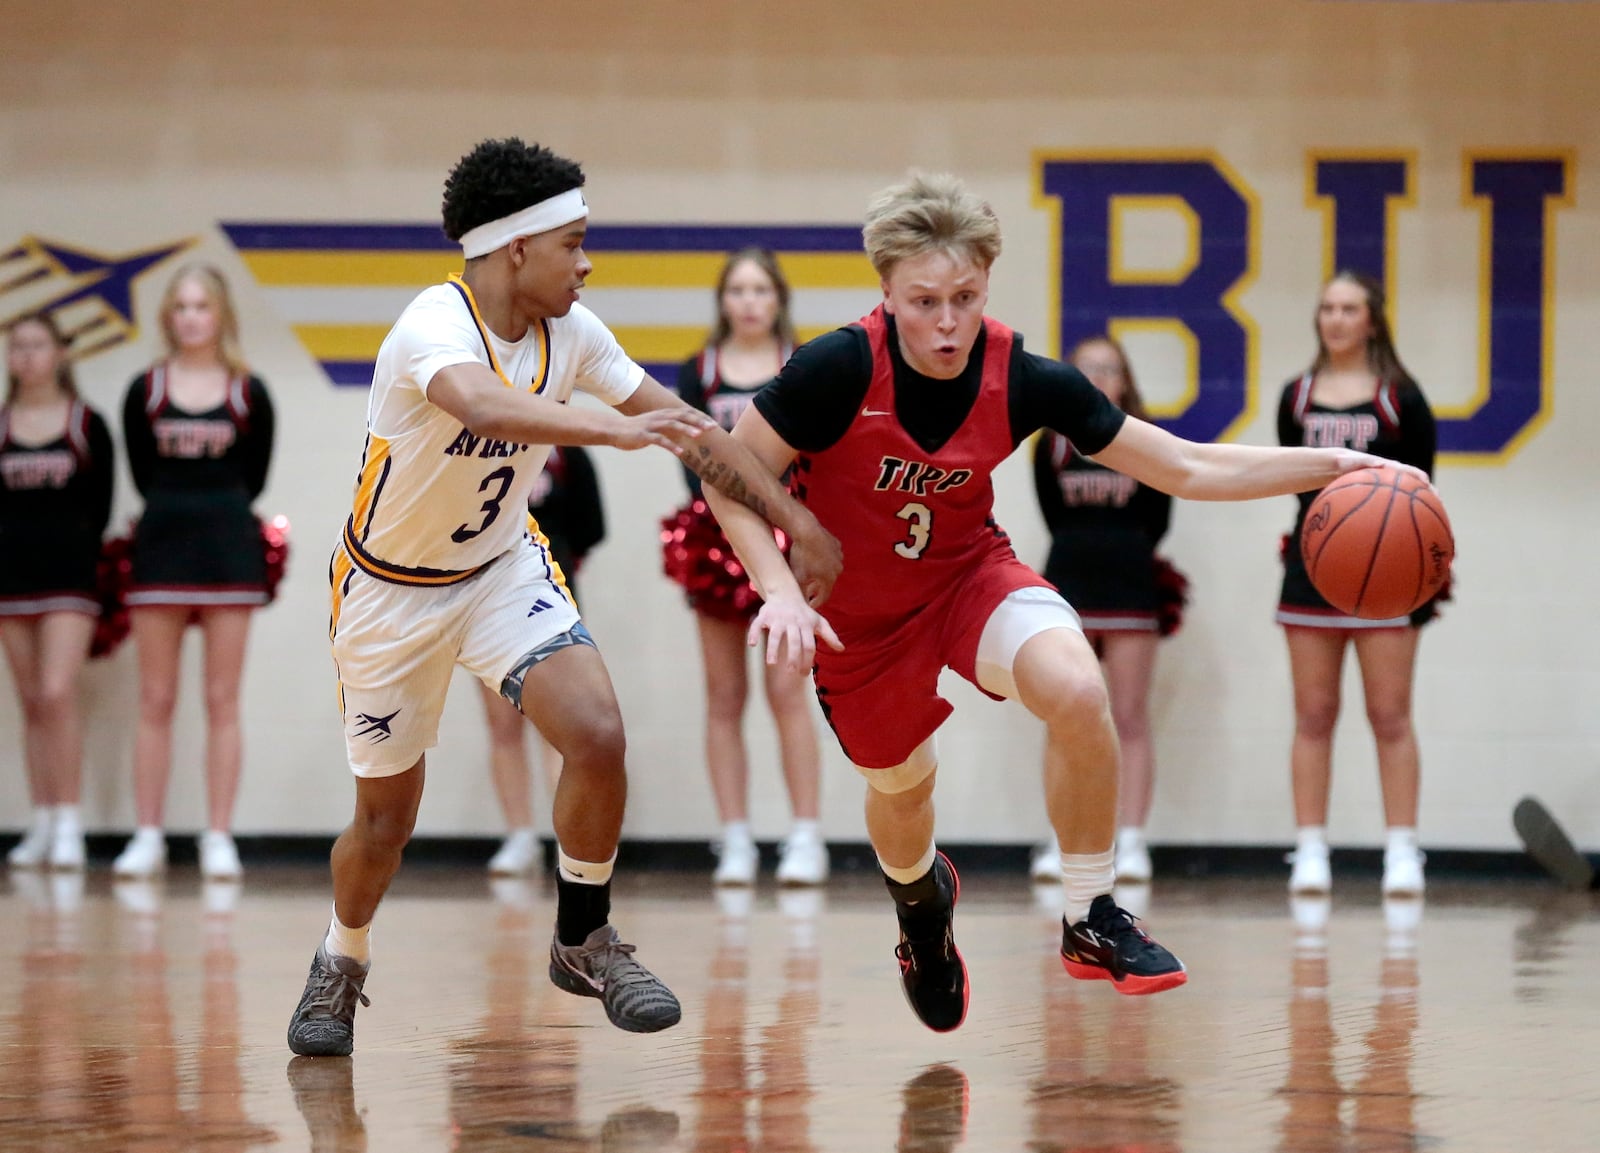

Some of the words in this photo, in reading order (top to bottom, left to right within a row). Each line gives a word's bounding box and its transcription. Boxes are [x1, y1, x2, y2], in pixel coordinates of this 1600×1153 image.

[1302, 412, 1378, 450] TIPP
[874, 456, 973, 496] TIPP
[451, 466, 515, 543] 3
[894, 502, 932, 560] 3
